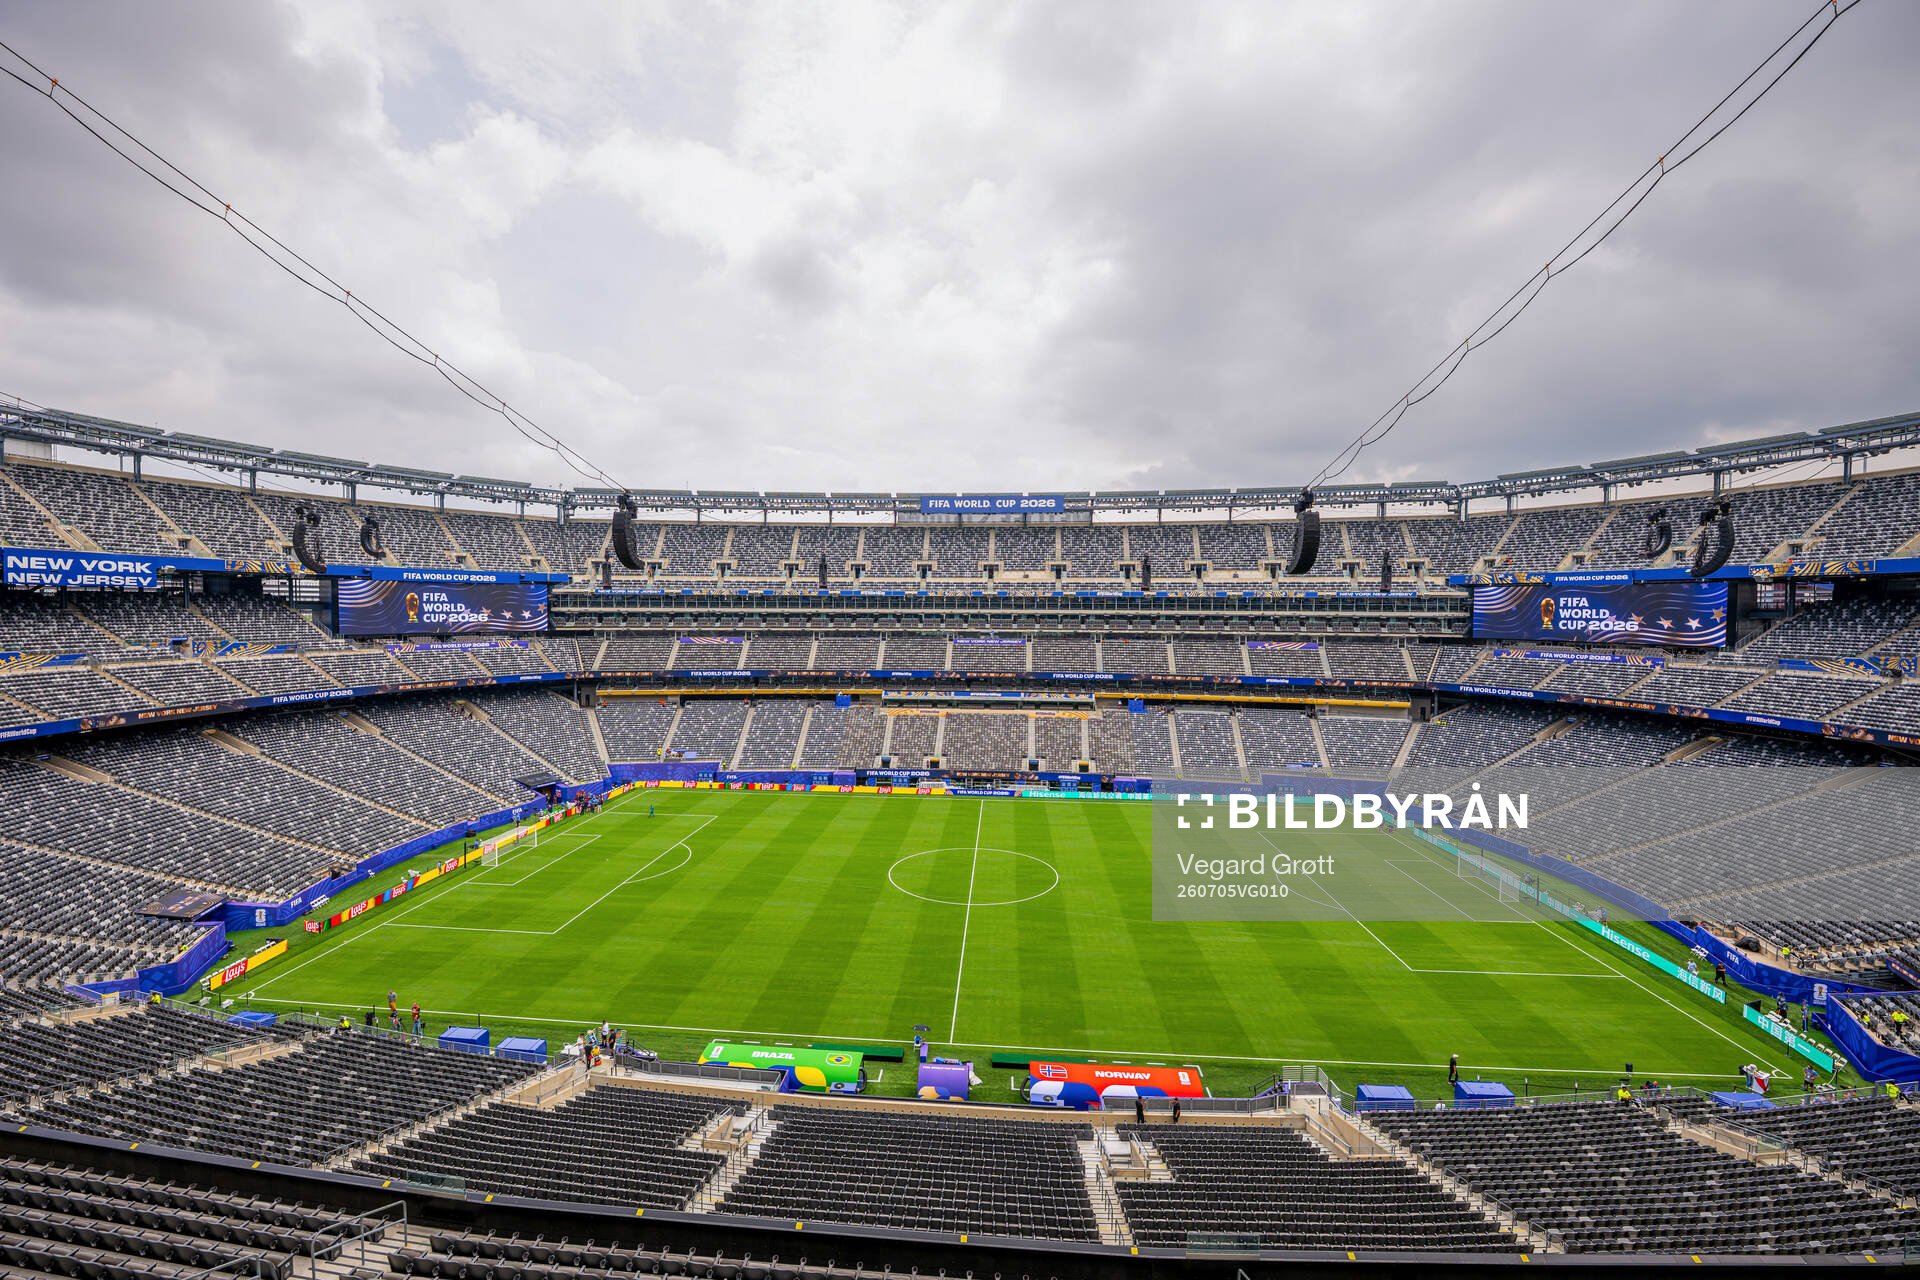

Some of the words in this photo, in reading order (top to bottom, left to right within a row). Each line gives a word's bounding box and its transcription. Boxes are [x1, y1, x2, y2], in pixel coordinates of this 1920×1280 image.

[929, 499, 950, 508] FIFA
[954, 499, 991, 508] WORLD
[996, 499, 1016, 508] CUP
[1020, 499, 1056, 507] 2026
[7, 556, 74, 571] NEW
[80, 559, 152, 574] YORK
[8, 573, 62, 584] NEW
[67, 575, 152, 586] JERSEY
[403, 572, 422, 580] FIFA
[422, 573, 452, 581] WORLD
[423, 592, 448, 602] FIFA
[1559, 597, 1589, 607] FIFA
[423, 603, 465, 612] WORLD
[1559, 608, 1610, 619] WORLD
[423, 614, 447, 623] CUP
[448, 614, 488, 623] 2026
[1559, 620, 1586, 631] CUP
[1588, 621, 1639, 632] 2026
[273, 696, 288, 704] FIFA
[288, 693, 314, 702] WORLD
[314, 691, 329, 700] CUP
[329, 689, 353, 697] 2026
[1459, 685, 1474, 693] FIFA
[1510, 690, 1534, 698] 2026
[138, 711, 156, 720] NEW
[176, 707, 192, 715] NEW
[192, 704, 218, 713] JERSEY
[1887, 735, 1908, 744] NEW
[1029, 790, 1066, 798] Hisense
[290, 897, 303, 909] FIFA
[350, 900, 368, 918] Lay's
[305, 920, 319, 933] Lay's
[1601, 925, 1650, 963] Hisense
[1726, 950, 1740, 965] FIFA
[225, 962, 246, 982] Lay's
[1757, 1015, 1811, 1054] 中国第一
[752, 1051, 795, 1060] BRAZIL
[1095, 1070, 1151, 1080] NORWAY
